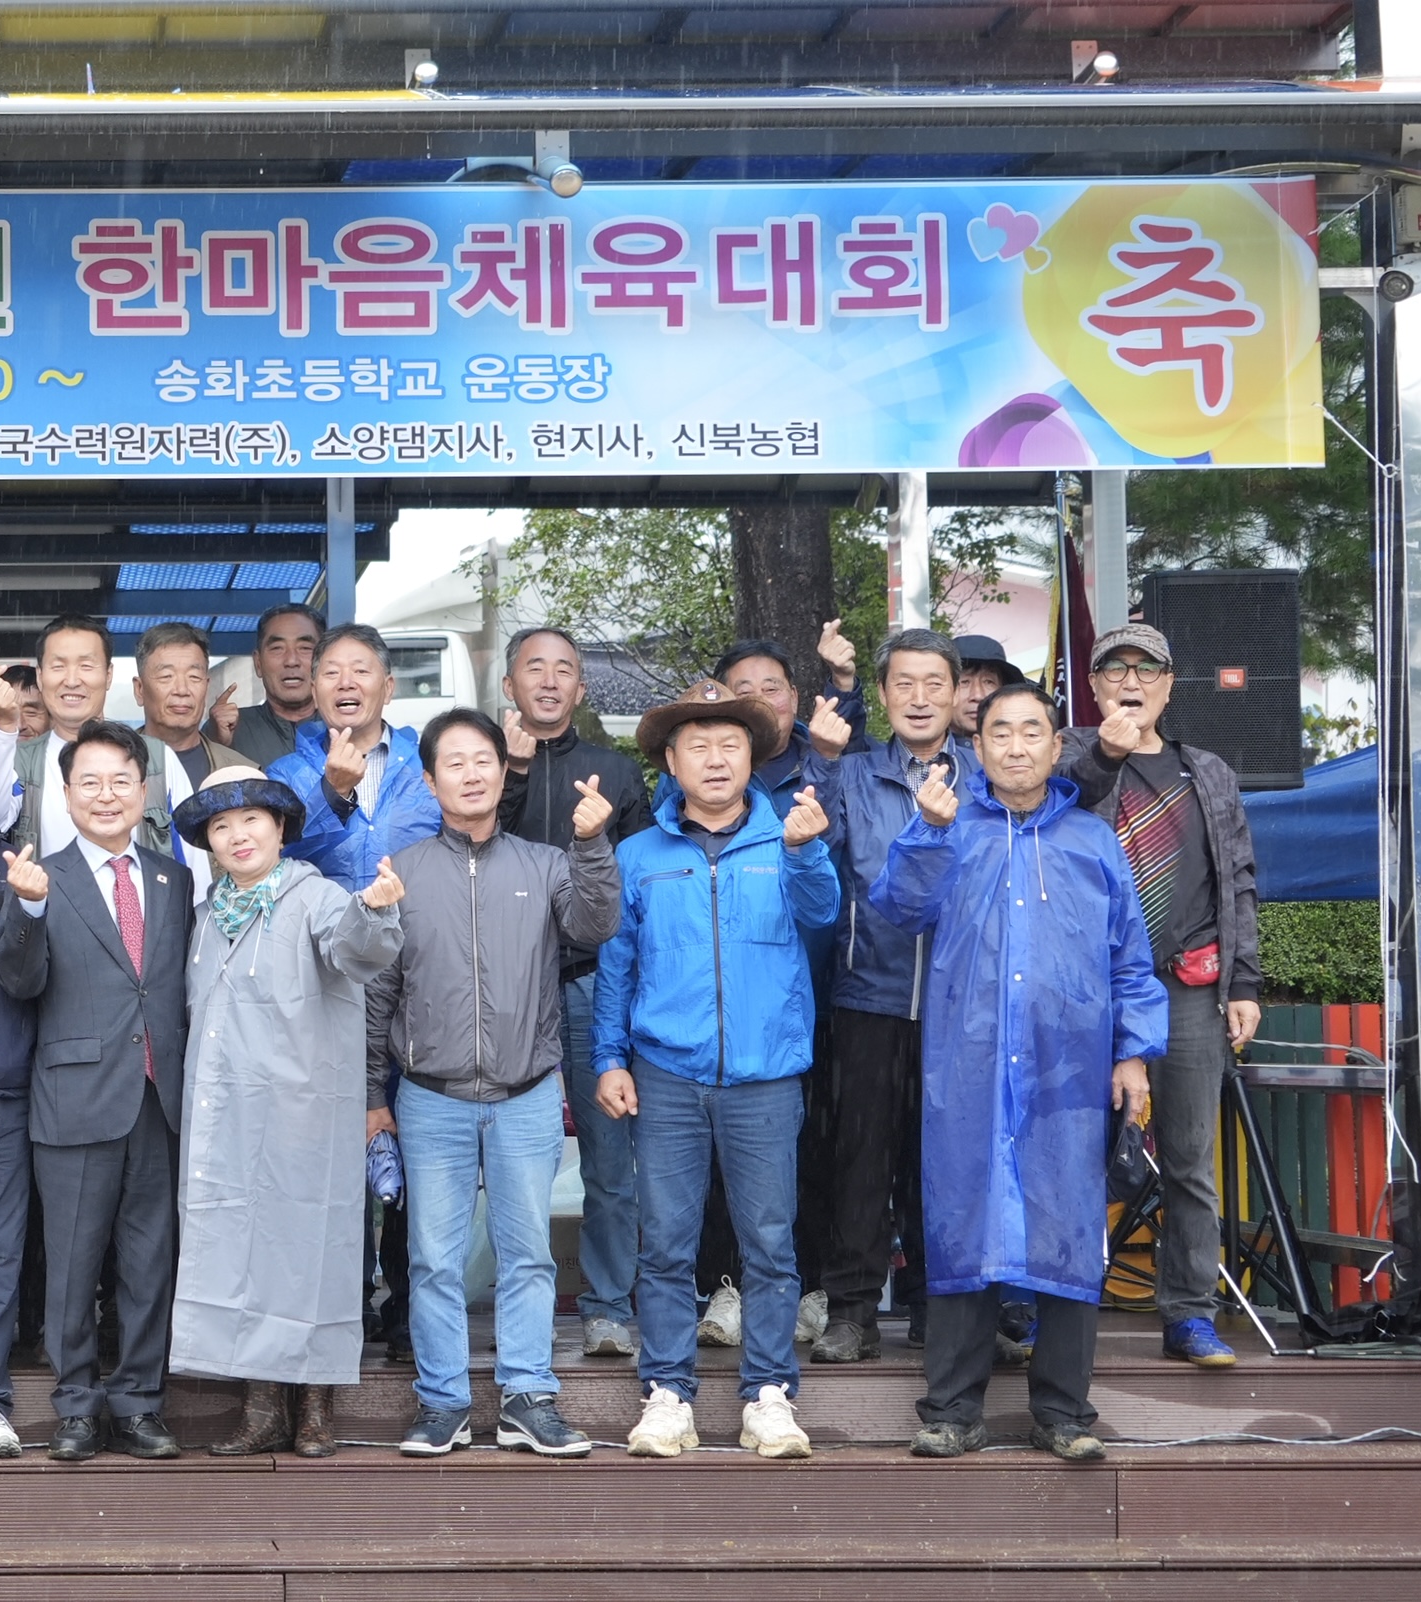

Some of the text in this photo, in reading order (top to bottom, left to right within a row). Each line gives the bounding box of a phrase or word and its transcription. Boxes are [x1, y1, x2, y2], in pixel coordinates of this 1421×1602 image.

[79, 216, 944, 331] 한마음체육대회
[1087, 221, 1256, 410] 축
[154, 358, 443, 403] 송화초등학교
[464, 356, 609, 400] 운동장
[313, 424, 514, 462] 소양댐지사,
[531, 423, 655, 460] 현지사,
[672, 421, 821, 457] 신북농협
[1224, 674, 1241, 683] JBL
